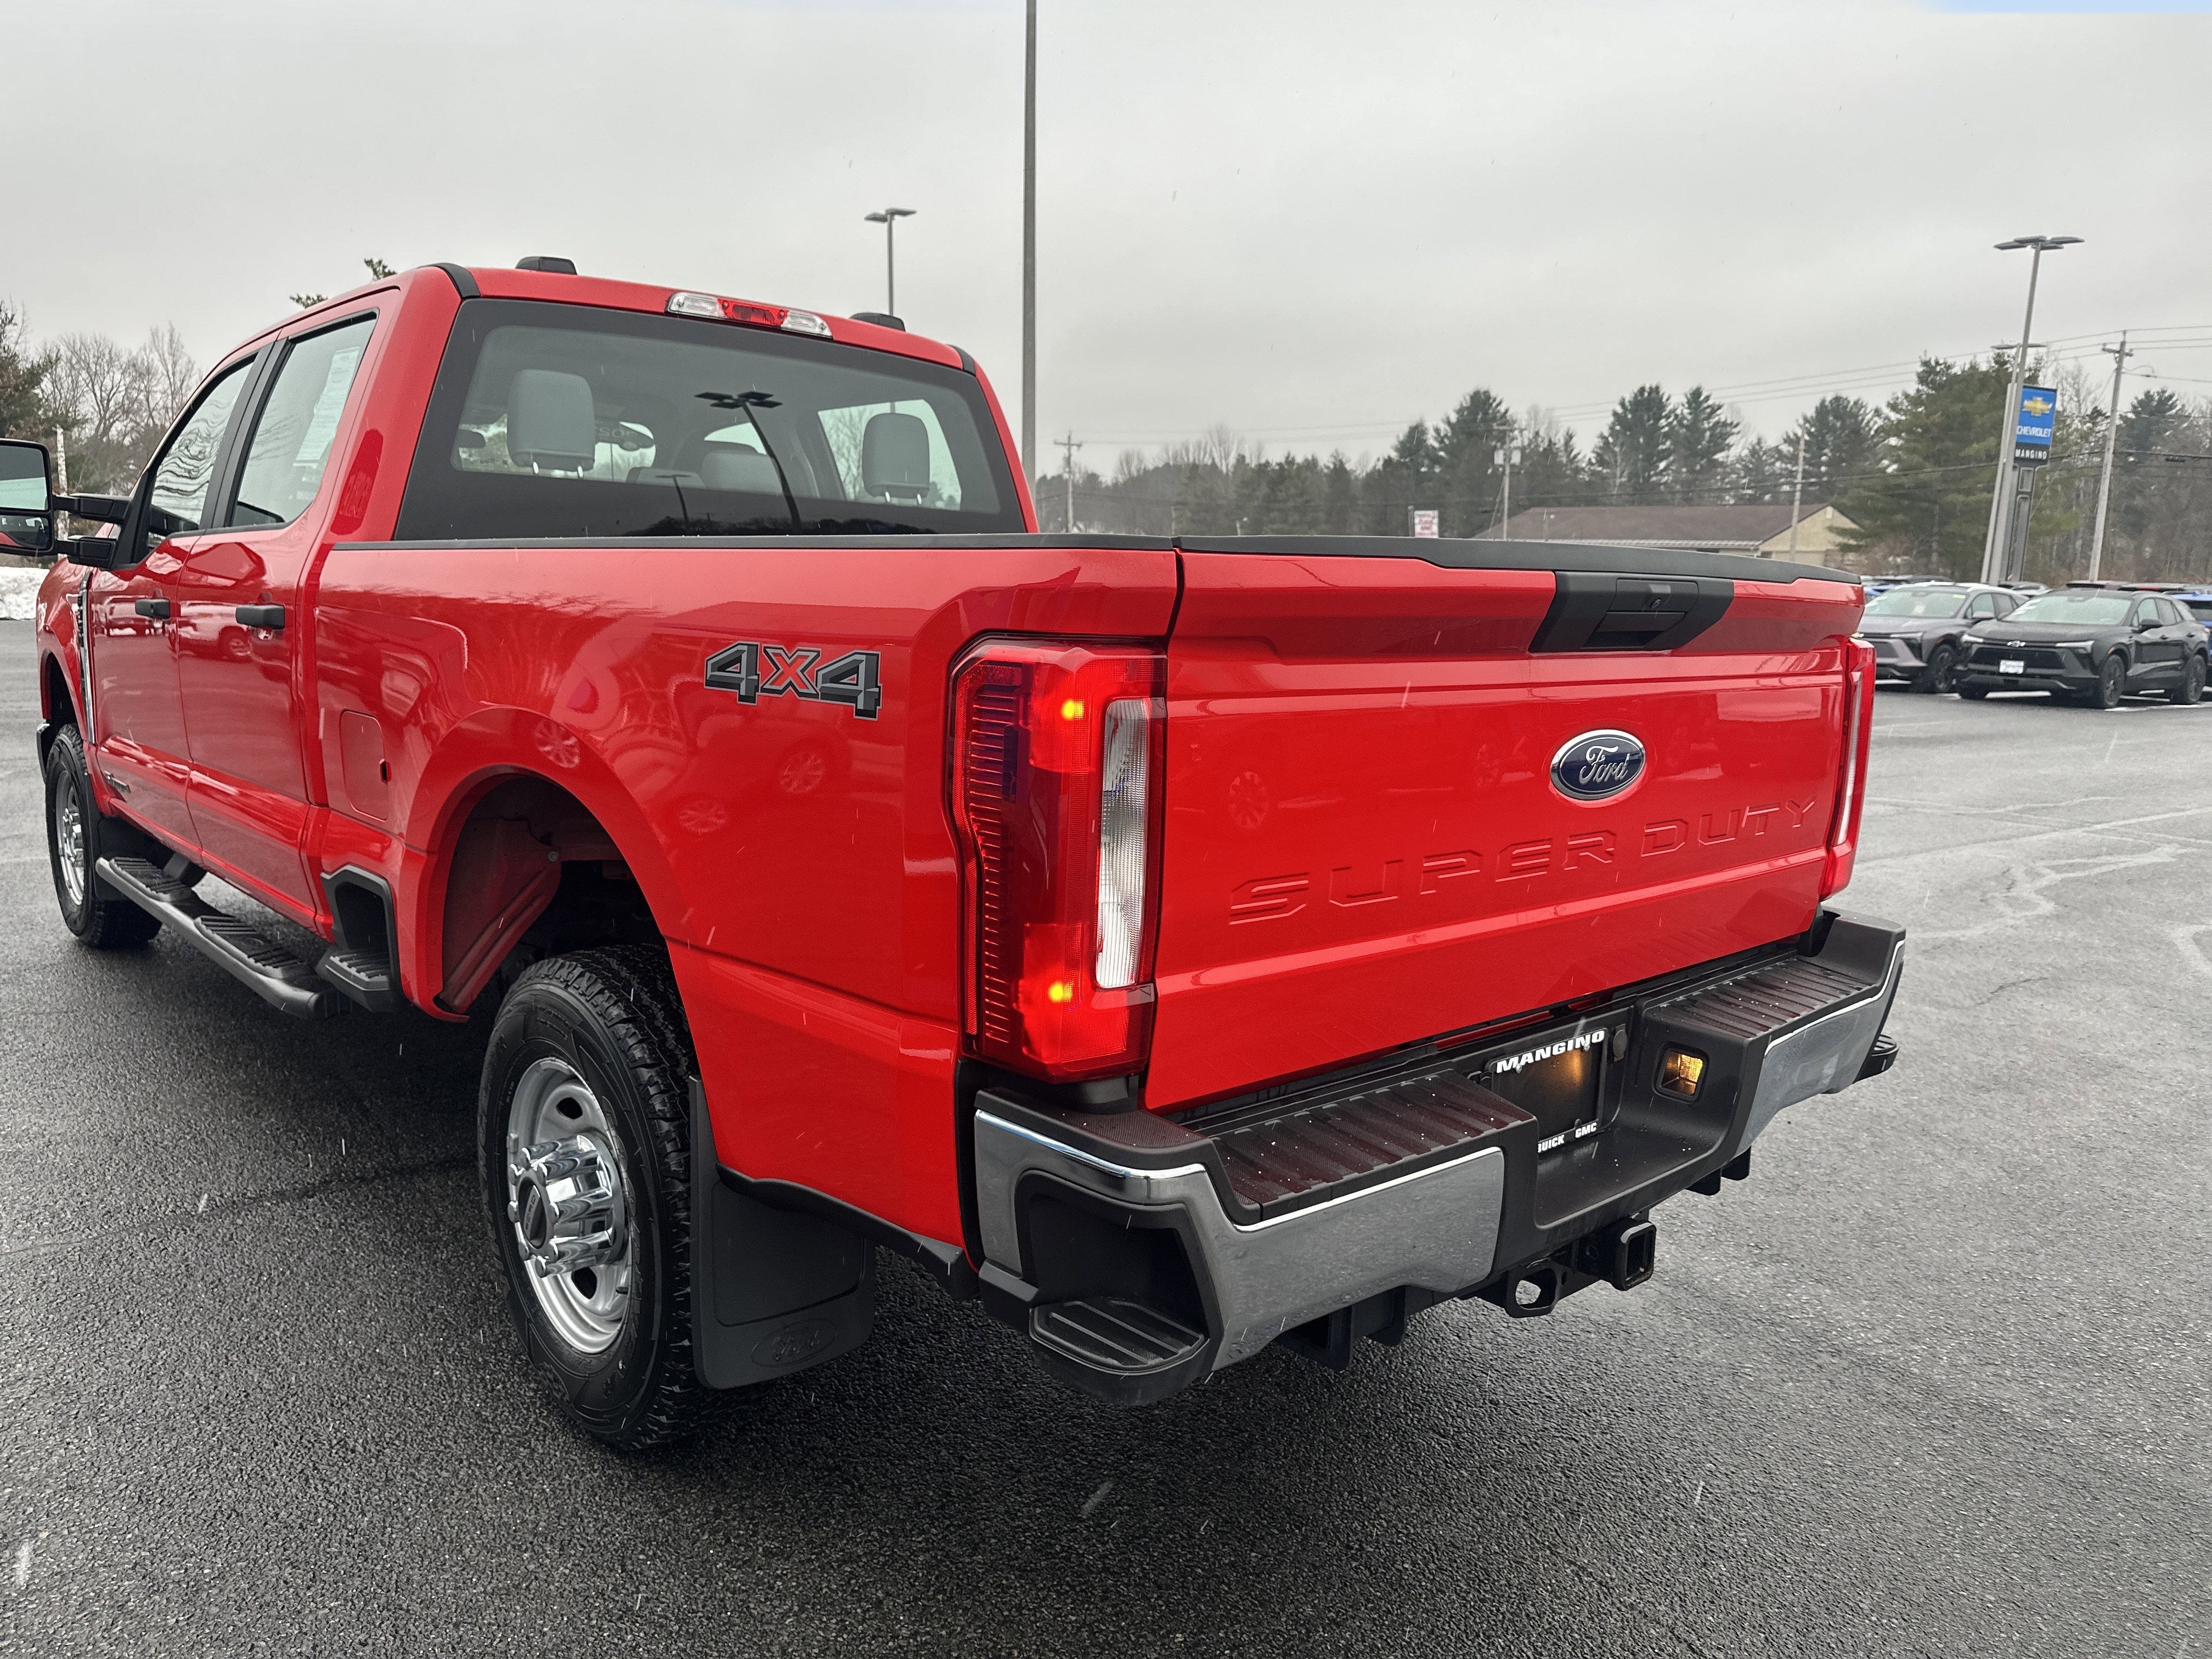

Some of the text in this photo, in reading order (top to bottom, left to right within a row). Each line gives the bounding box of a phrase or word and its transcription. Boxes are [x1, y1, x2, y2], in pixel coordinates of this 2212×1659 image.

[2017, 425, 2052, 437] CHEVROLET
[2015, 448, 2047, 460] MANGINO
[1579, 746, 1630, 785] Ford
[1229, 795, 1815, 926] SUPER DUTY
[1496, 1030, 1605, 1074] MANGINO
[1575, 1122, 1597, 1138] GMC
